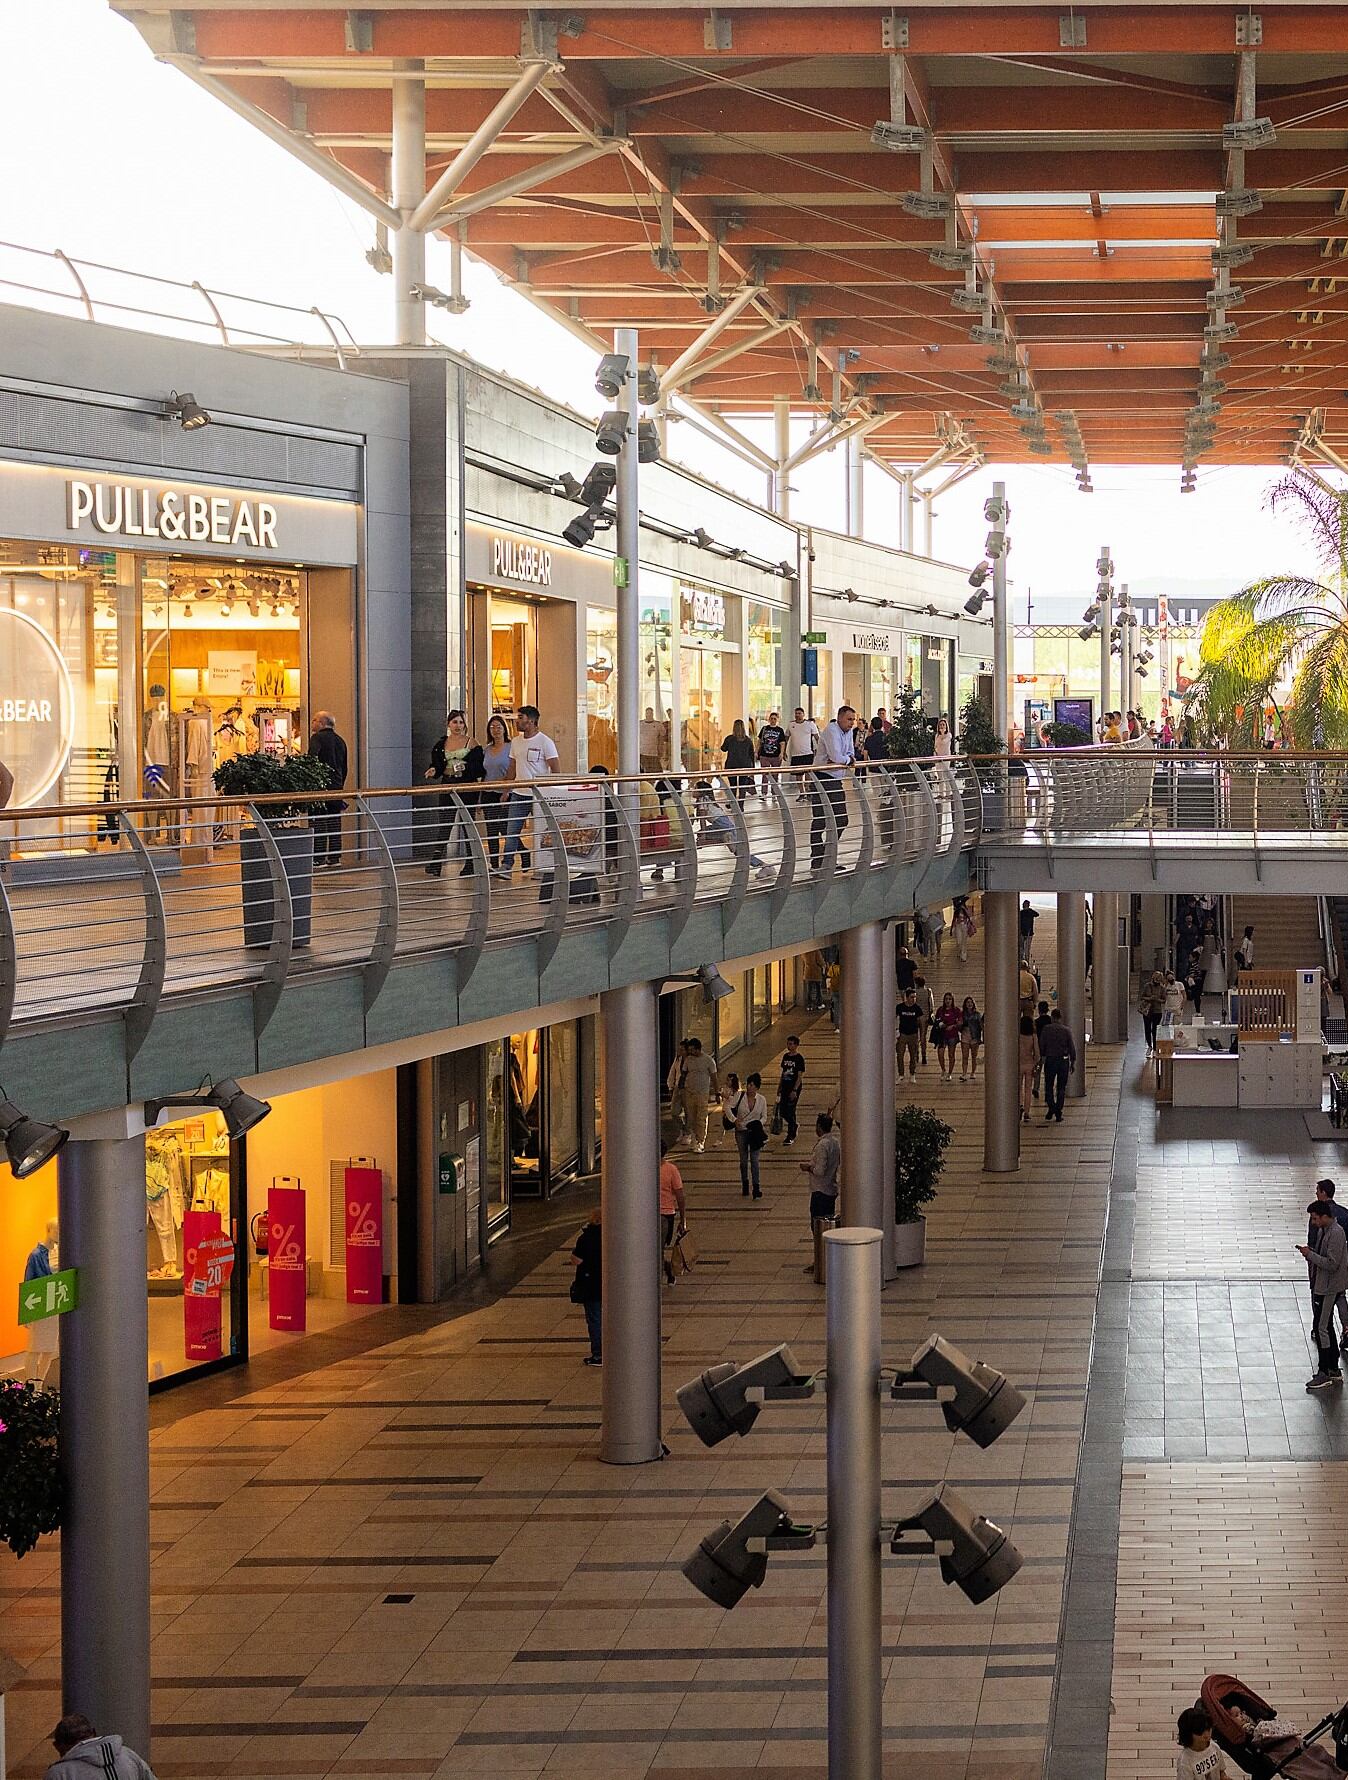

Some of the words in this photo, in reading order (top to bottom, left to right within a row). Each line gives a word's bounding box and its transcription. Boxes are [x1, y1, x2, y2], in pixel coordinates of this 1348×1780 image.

[66, 480, 279, 548] PULL&BEAR
[494, 537, 552, 586] PULL&BEAR
[0, 699, 53, 722] BEAR
